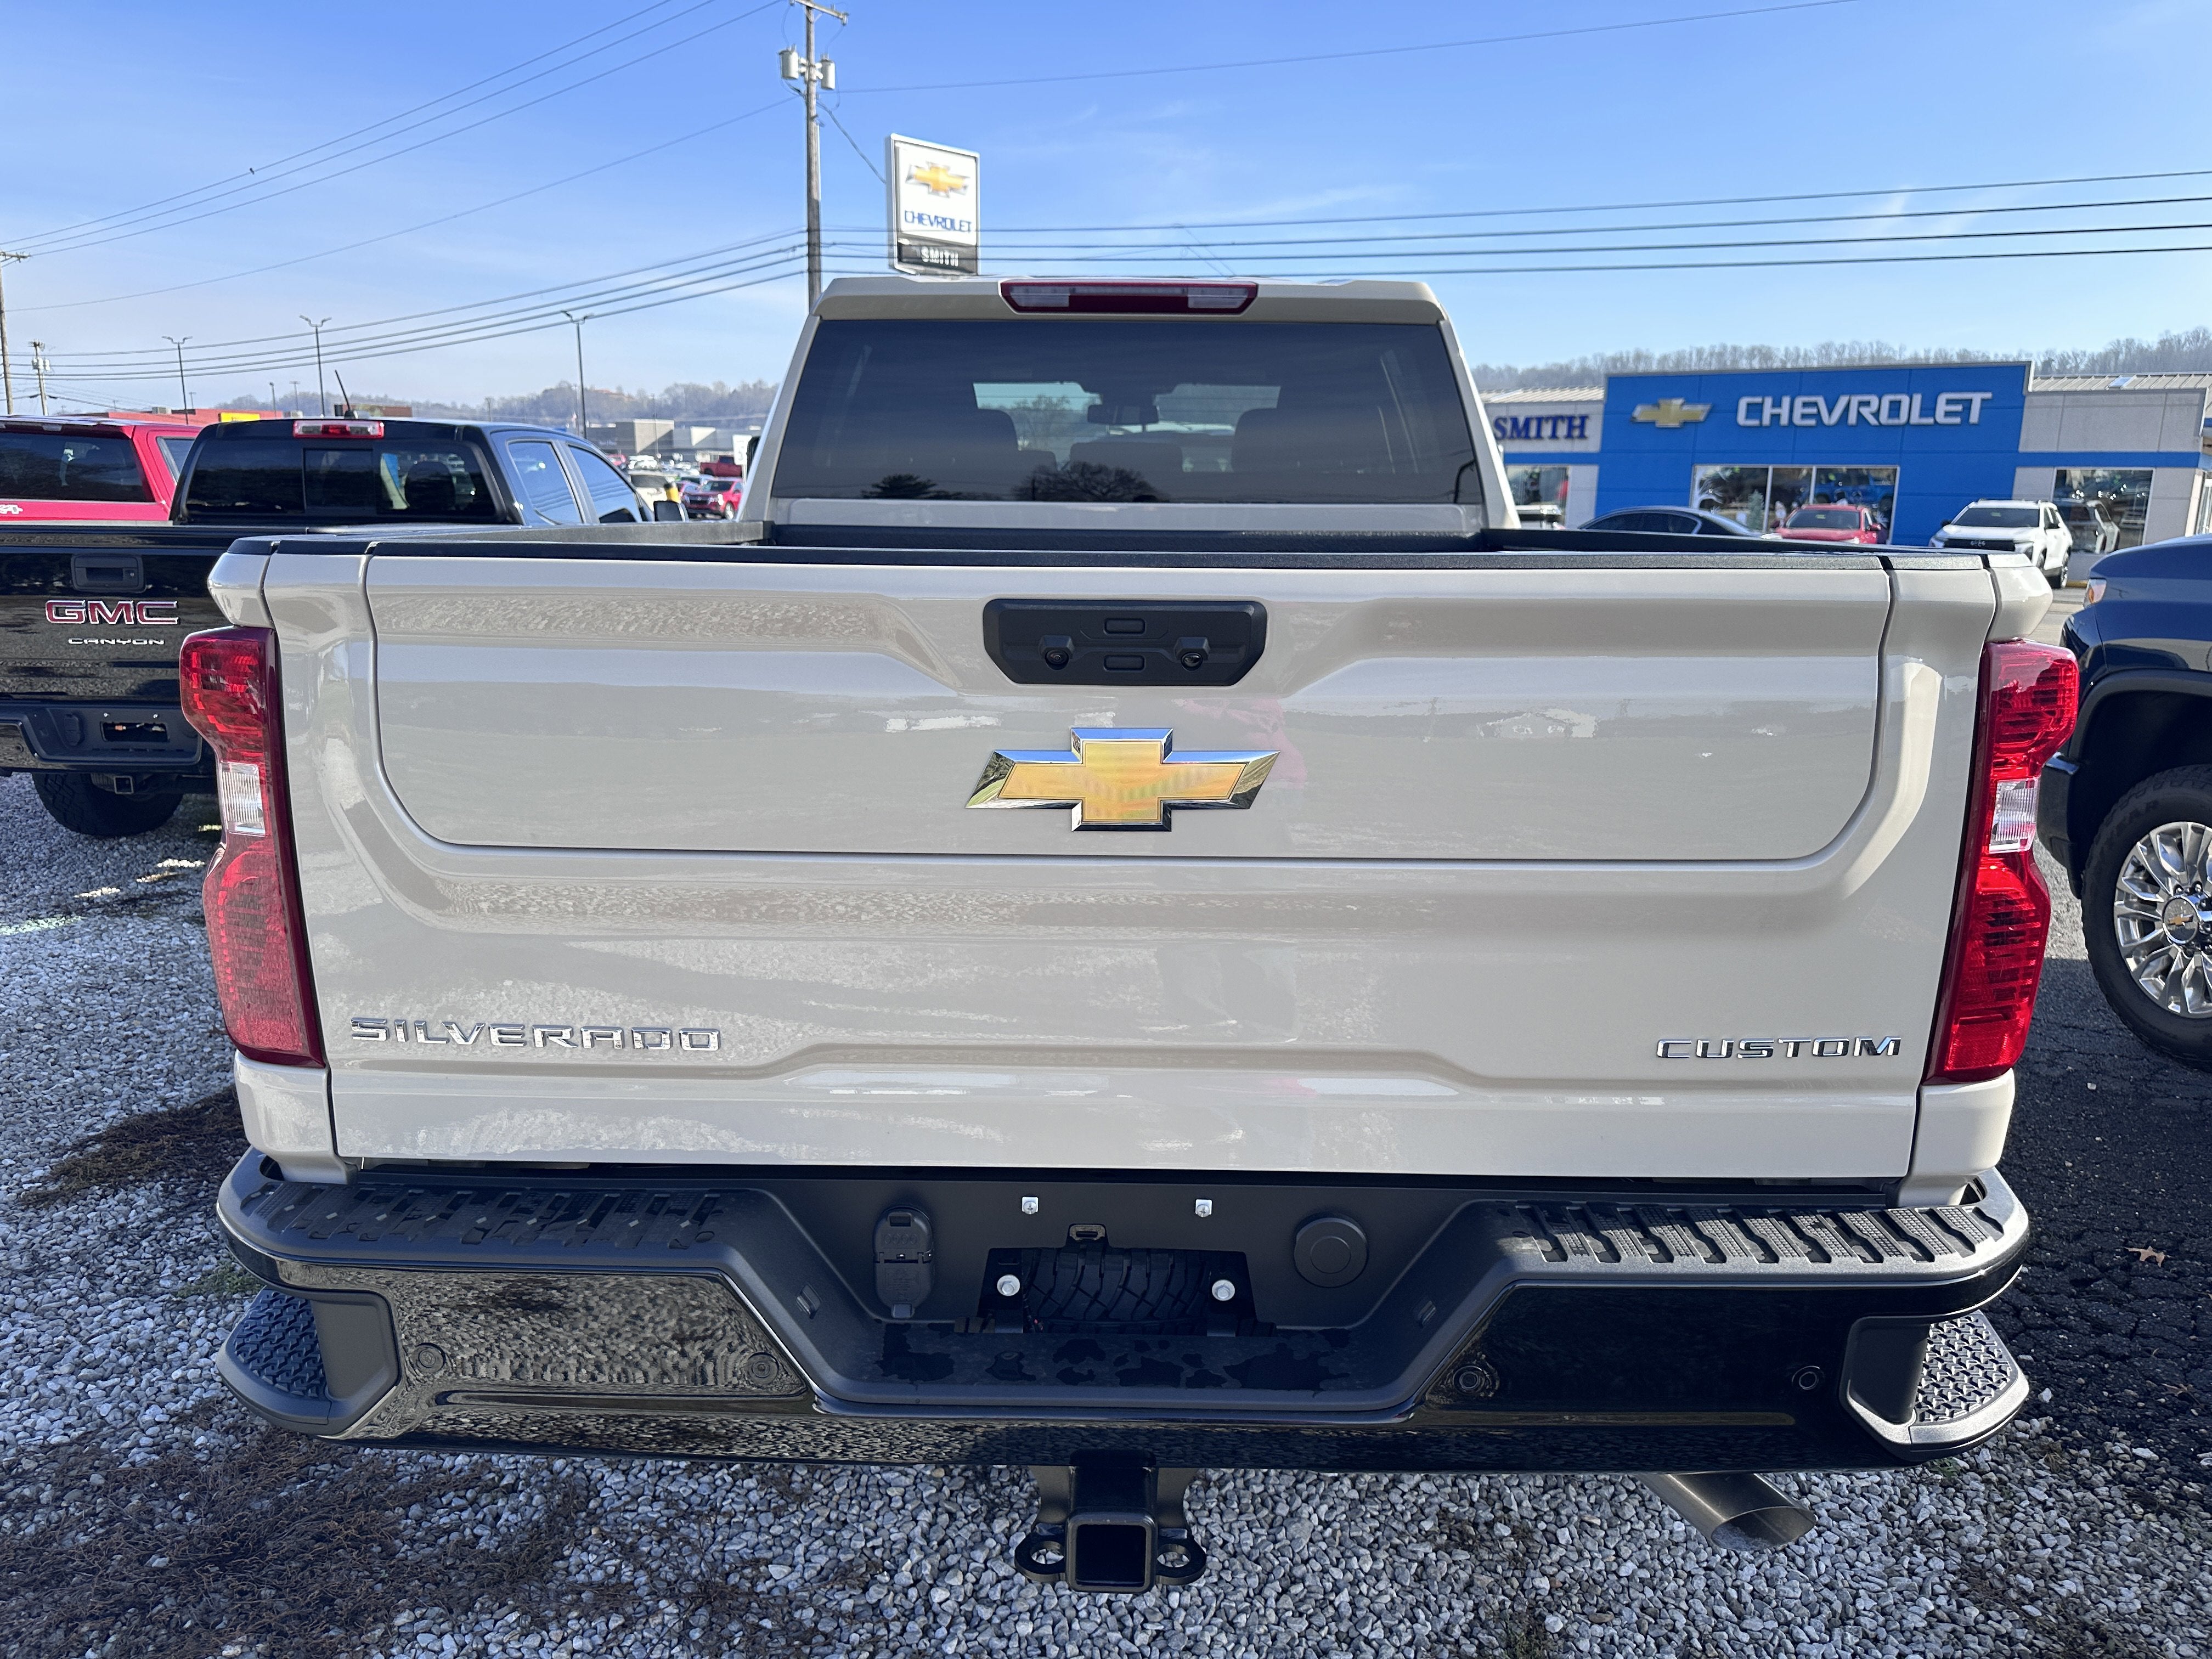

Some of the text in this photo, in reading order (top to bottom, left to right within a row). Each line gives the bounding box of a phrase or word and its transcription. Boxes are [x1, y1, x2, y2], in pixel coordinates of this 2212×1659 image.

[905, 210, 972, 233] CHEVROLET
[921, 246, 959, 267] SMITH
[1736, 392, 1993, 427] CHEVROLET
[1494, 415, 1589, 440] SMITH
[46, 600, 179, 625] GMC
[350, 1017, 721, 1051] SILVERADO
[1656, 1036, 1901, 1058] CUSTOM
